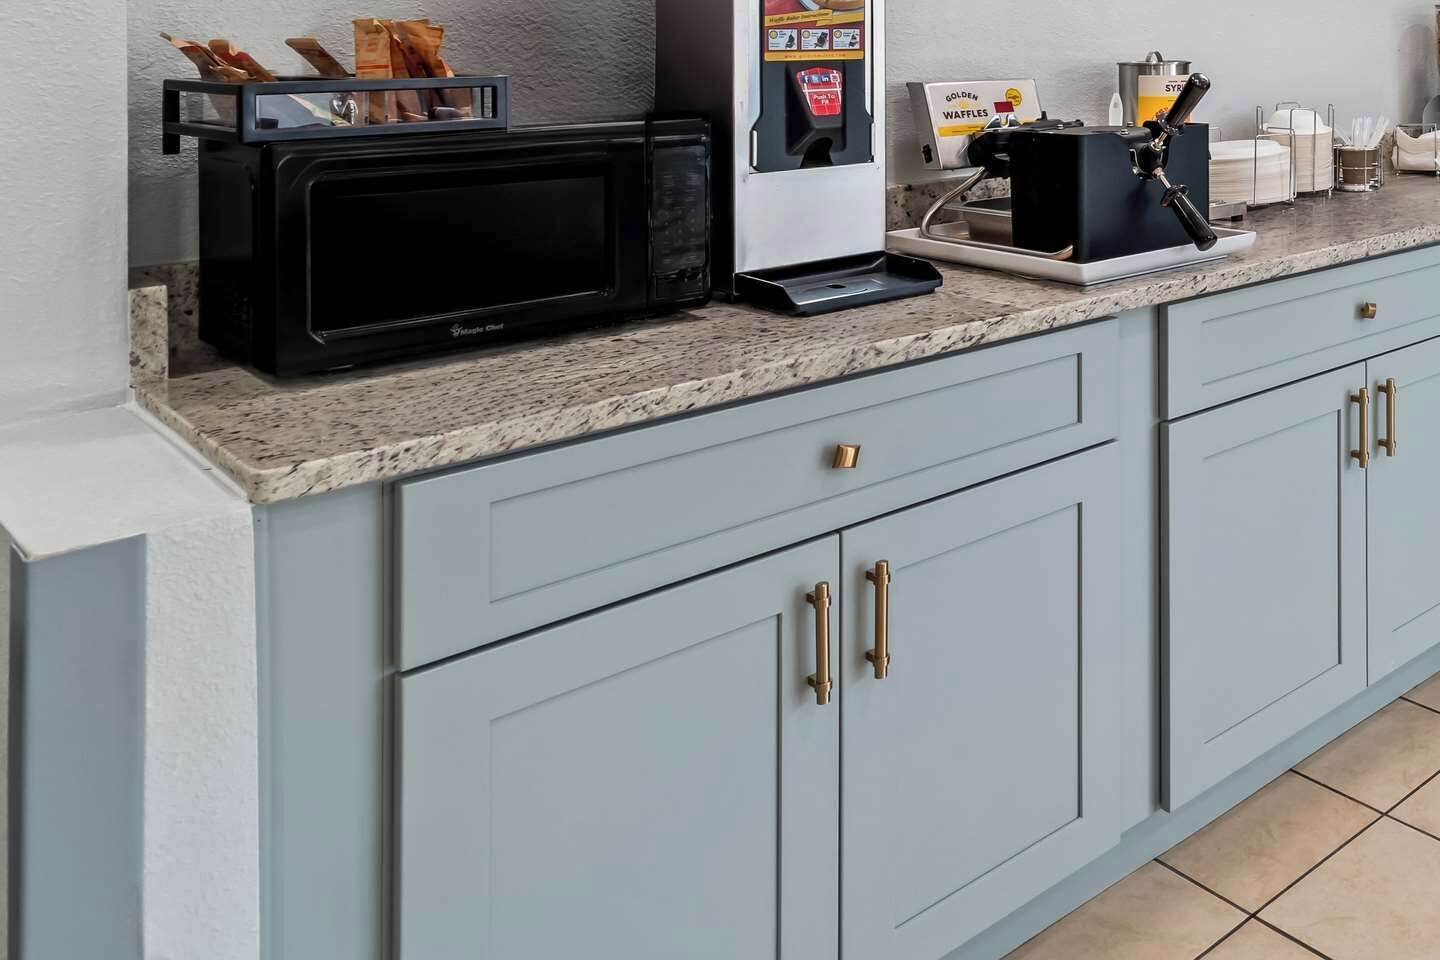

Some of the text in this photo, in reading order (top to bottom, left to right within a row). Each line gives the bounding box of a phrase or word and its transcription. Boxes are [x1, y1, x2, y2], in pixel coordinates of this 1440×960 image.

[945, 91, 979, 103] GOLDEN
[942, 108, 989, 120] WAFFLES
[460, 326, 484, 336] Magic
